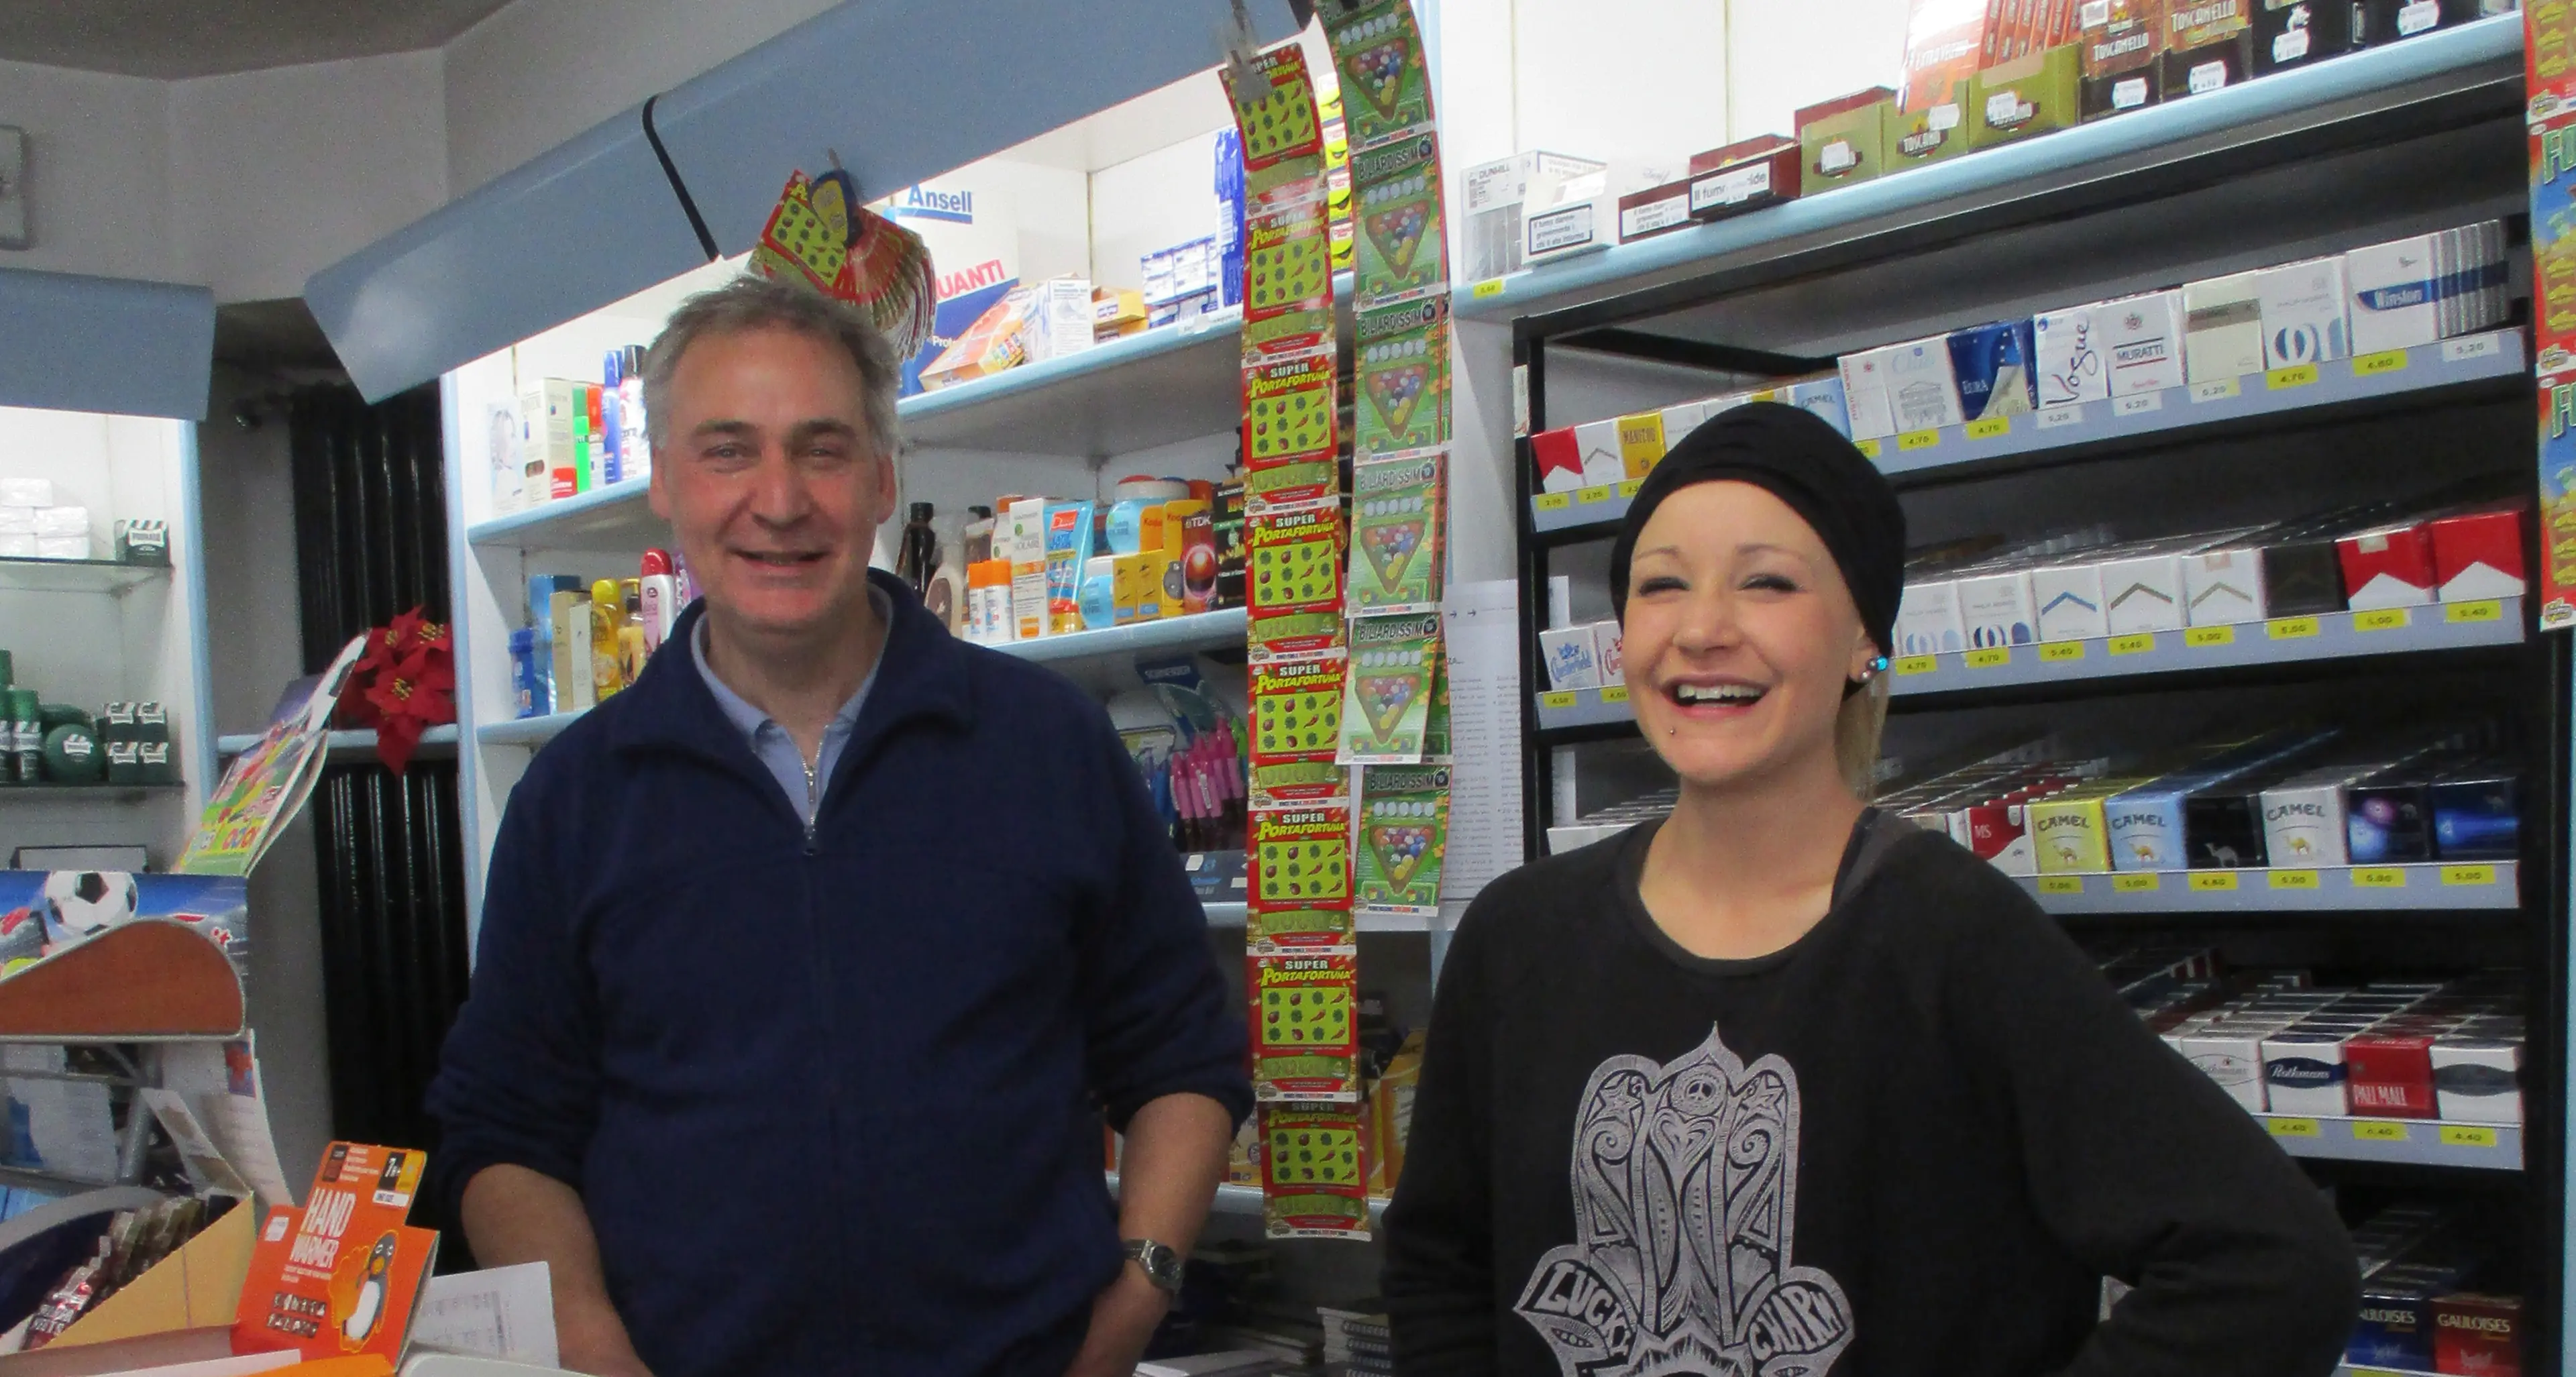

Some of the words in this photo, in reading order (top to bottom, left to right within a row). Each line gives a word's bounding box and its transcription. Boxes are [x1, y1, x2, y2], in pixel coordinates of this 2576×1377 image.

[906, 184, 973, 213] Ansell
[1271, 211, 1305, 229] SUPER
[936, 259, 1006, 300] UANTI
[2375, 288, 2423, 309] Winston
[2045, 313, 2098, 404] Vogue
[2116, 344, 2163, 361] MURATTI
[1270, 362, 1309, 378] SUPER
[1251, 371, 1330, 398] PORTAFORTUNA
[1192, 514, 1212, 527] TDK
[1275, 514, 1316, 528] SUPER
[1252, 522, 1335, 547] PORTAFORTUNA
[1279, 664, 1320, 677] SUPER
[1256, 672, 1341, 694] PORTAFORTUNA
[1282, 812, 1324, 824] SUPER
[2266, 804, 2326, 821] CAMEL
[2037, 815, 2091, 831] CAMEL
[2112, 814, 2167, 830] CAMEL
[1258, 822, 1345, 841] PORTAFORTUNA
[1974, 824, 1992, 839] MS
[1285, 960, 1328, 970] SUPER
[1261, 968, 1351, 987] PORTAFORTUNA
[2271, 1064, 2331, 1080] Rothmans
[2353, 1084, 2377, 1105] PALL
[2379, 1085, 2406, 1106] MALL
[302, 1187, 356, 1237] HAND
[290, 1232, 339, 1268] WARMER
[1751, 1284, 1845, 1361] CHARM
[2359, 1309, 2416, 1324] ULOISES
[2438, 1313, 2510, 1333] GAULOISES
